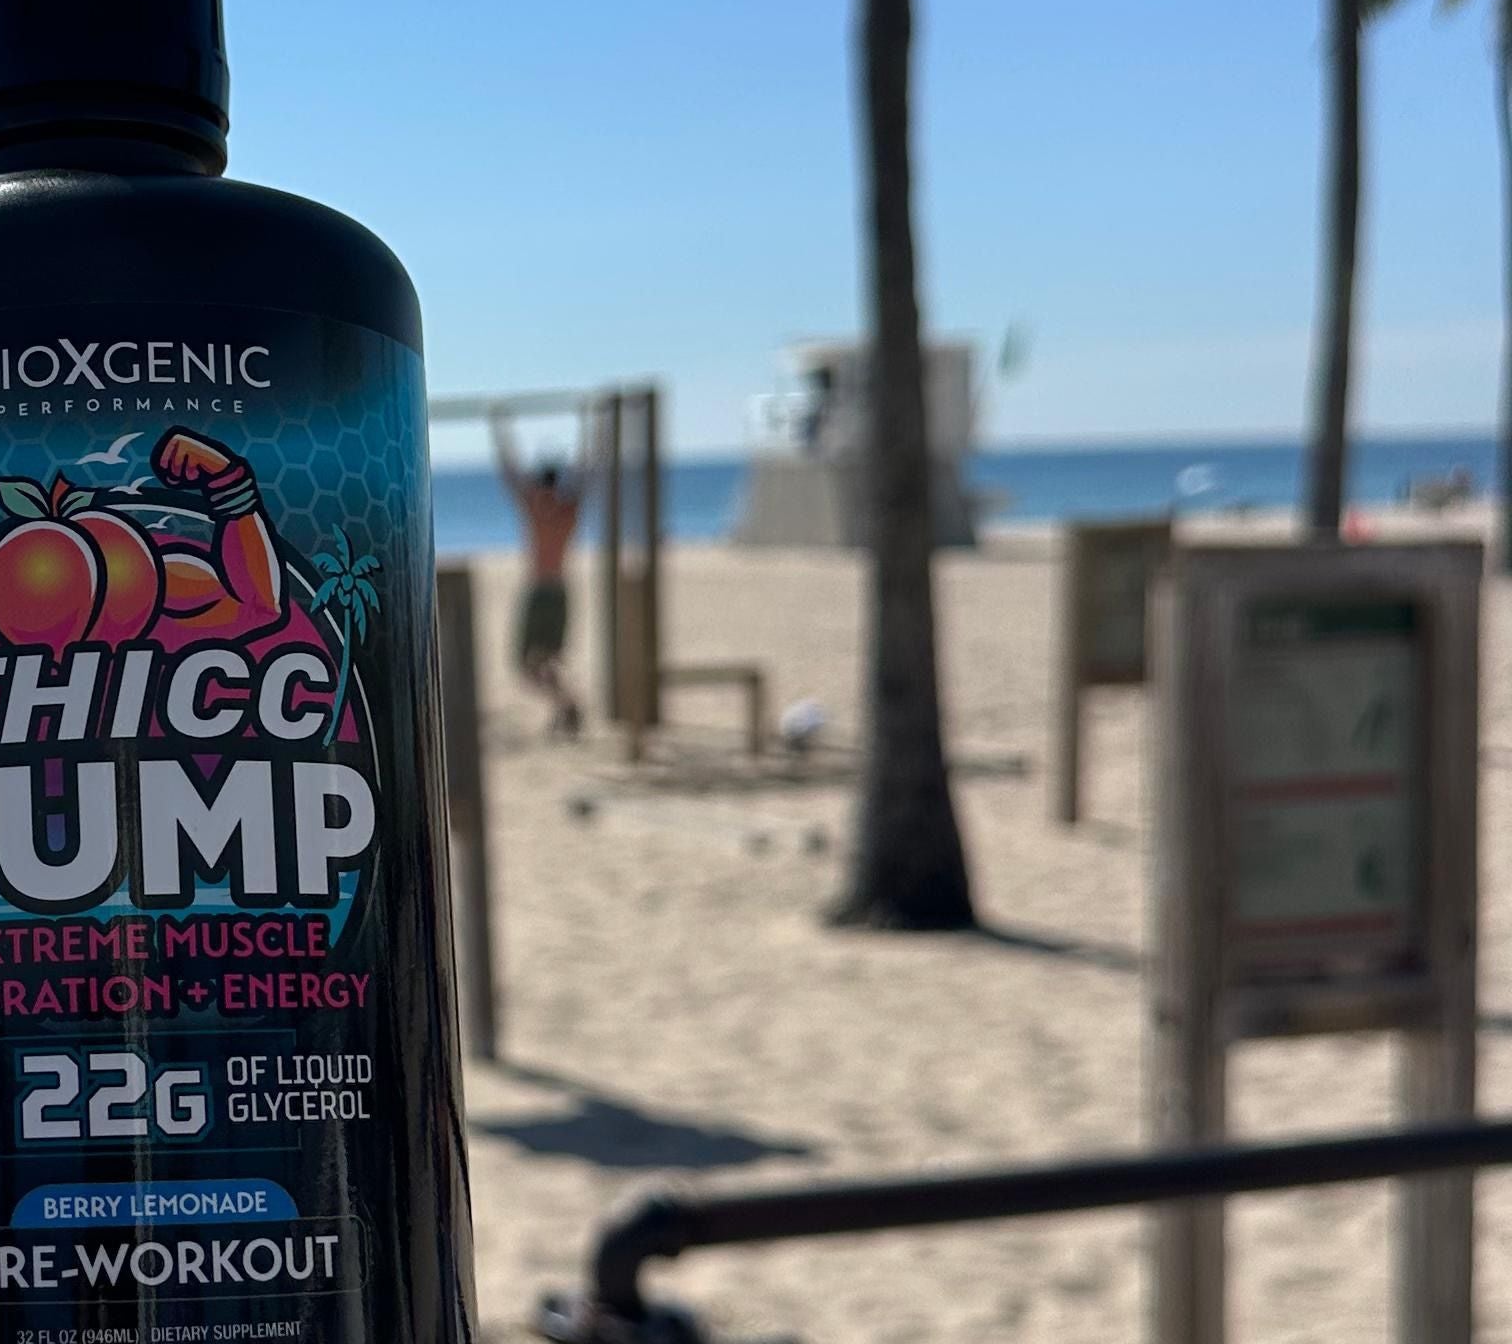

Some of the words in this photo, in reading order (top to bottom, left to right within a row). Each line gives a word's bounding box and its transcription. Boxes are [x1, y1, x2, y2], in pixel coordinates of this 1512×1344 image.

[166, 921, 326, 960] MUSCLE
[186, 981, 209, 1003] +
[224, 973, 371, 1010] ENERGY
[226, 1056, 267, 1086] OF
[277, 1054, 373, 1089] LIQUID
[21, 1052, 207, 1139] 22G
[227, 1091, 371, 1123] GLYCEROL
[43, 1195, 122, 1220] BERRY
[130, 1190, 269, 1217] LEMONADE
[151, 1326, 209, 1343] DIETARY
[213, 1321, 302, 1341] SUPPLEMENT
